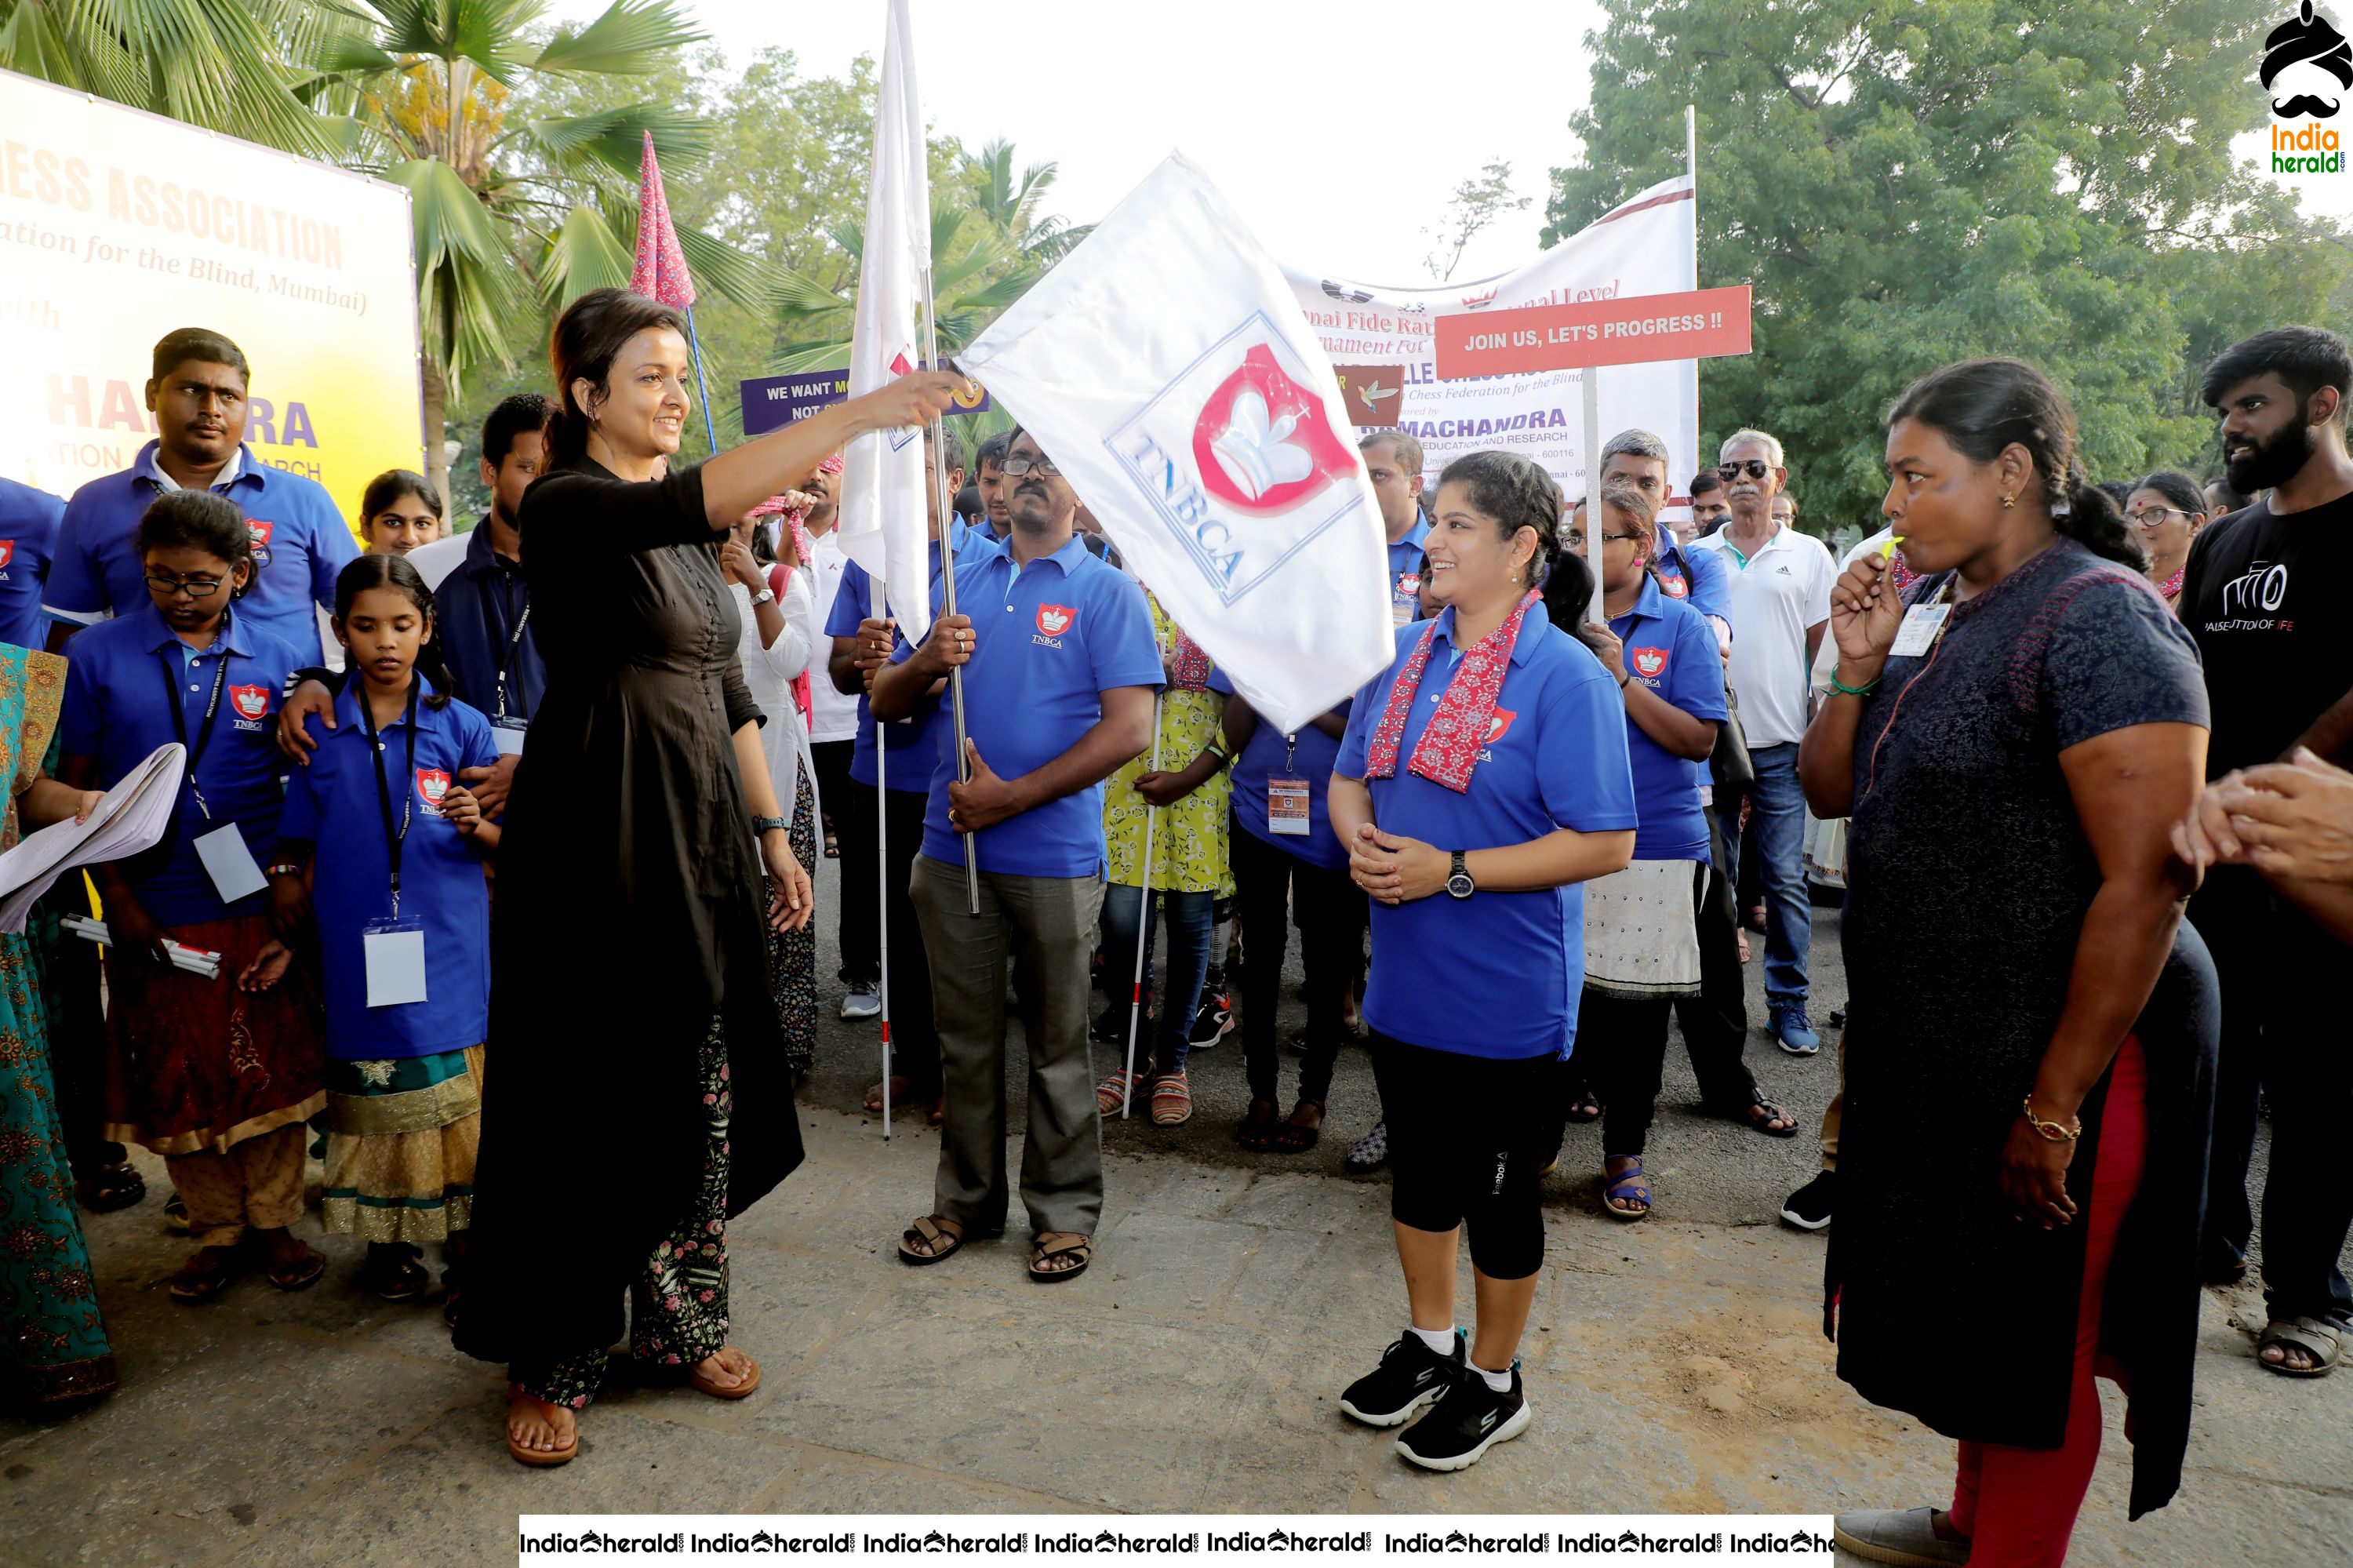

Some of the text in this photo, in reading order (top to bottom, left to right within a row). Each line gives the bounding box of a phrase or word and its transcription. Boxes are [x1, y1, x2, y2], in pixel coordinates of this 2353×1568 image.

[107, 167, 342, 270] ASSOCIATION
[82, 235, 129, 263] for
[138, 248, 180, 275] the
[188, 257, 260, 293] Blind,
[268, 273, 367, 316] Mumbai)
[1562, 279, 1620, 304] Level
[1303, 310, 1341, 329] nai
[1347, 311, 1392, 333] Fide
[1464, 312, 1722, 351] JOIN US, LET'S PROGRESS !!
[1318, 337, 1428, 355] nament For
[767, 387, 788, 401] WE
[791, 382, 831, 398] WANT
[1409, 388, 1442, 400] Chess
[1446, 385, 1510, 399] Federation
[1512, 383, 1530, 397] for
[1533, 379, 1550, 390] the
[792, 406, 820, 420] NOT
[1428, 407, 1439, 417] by
[1422, 432, 1568, 451] EDUCATION AND RESEARCH
[1542, 449, 1574, 458] 600116
[1129, 429, 1245, 584] TNBCA
[1031, 634, 1062, 648] TNBCA
[1492, 1162, 1506, 1195] Reebok
